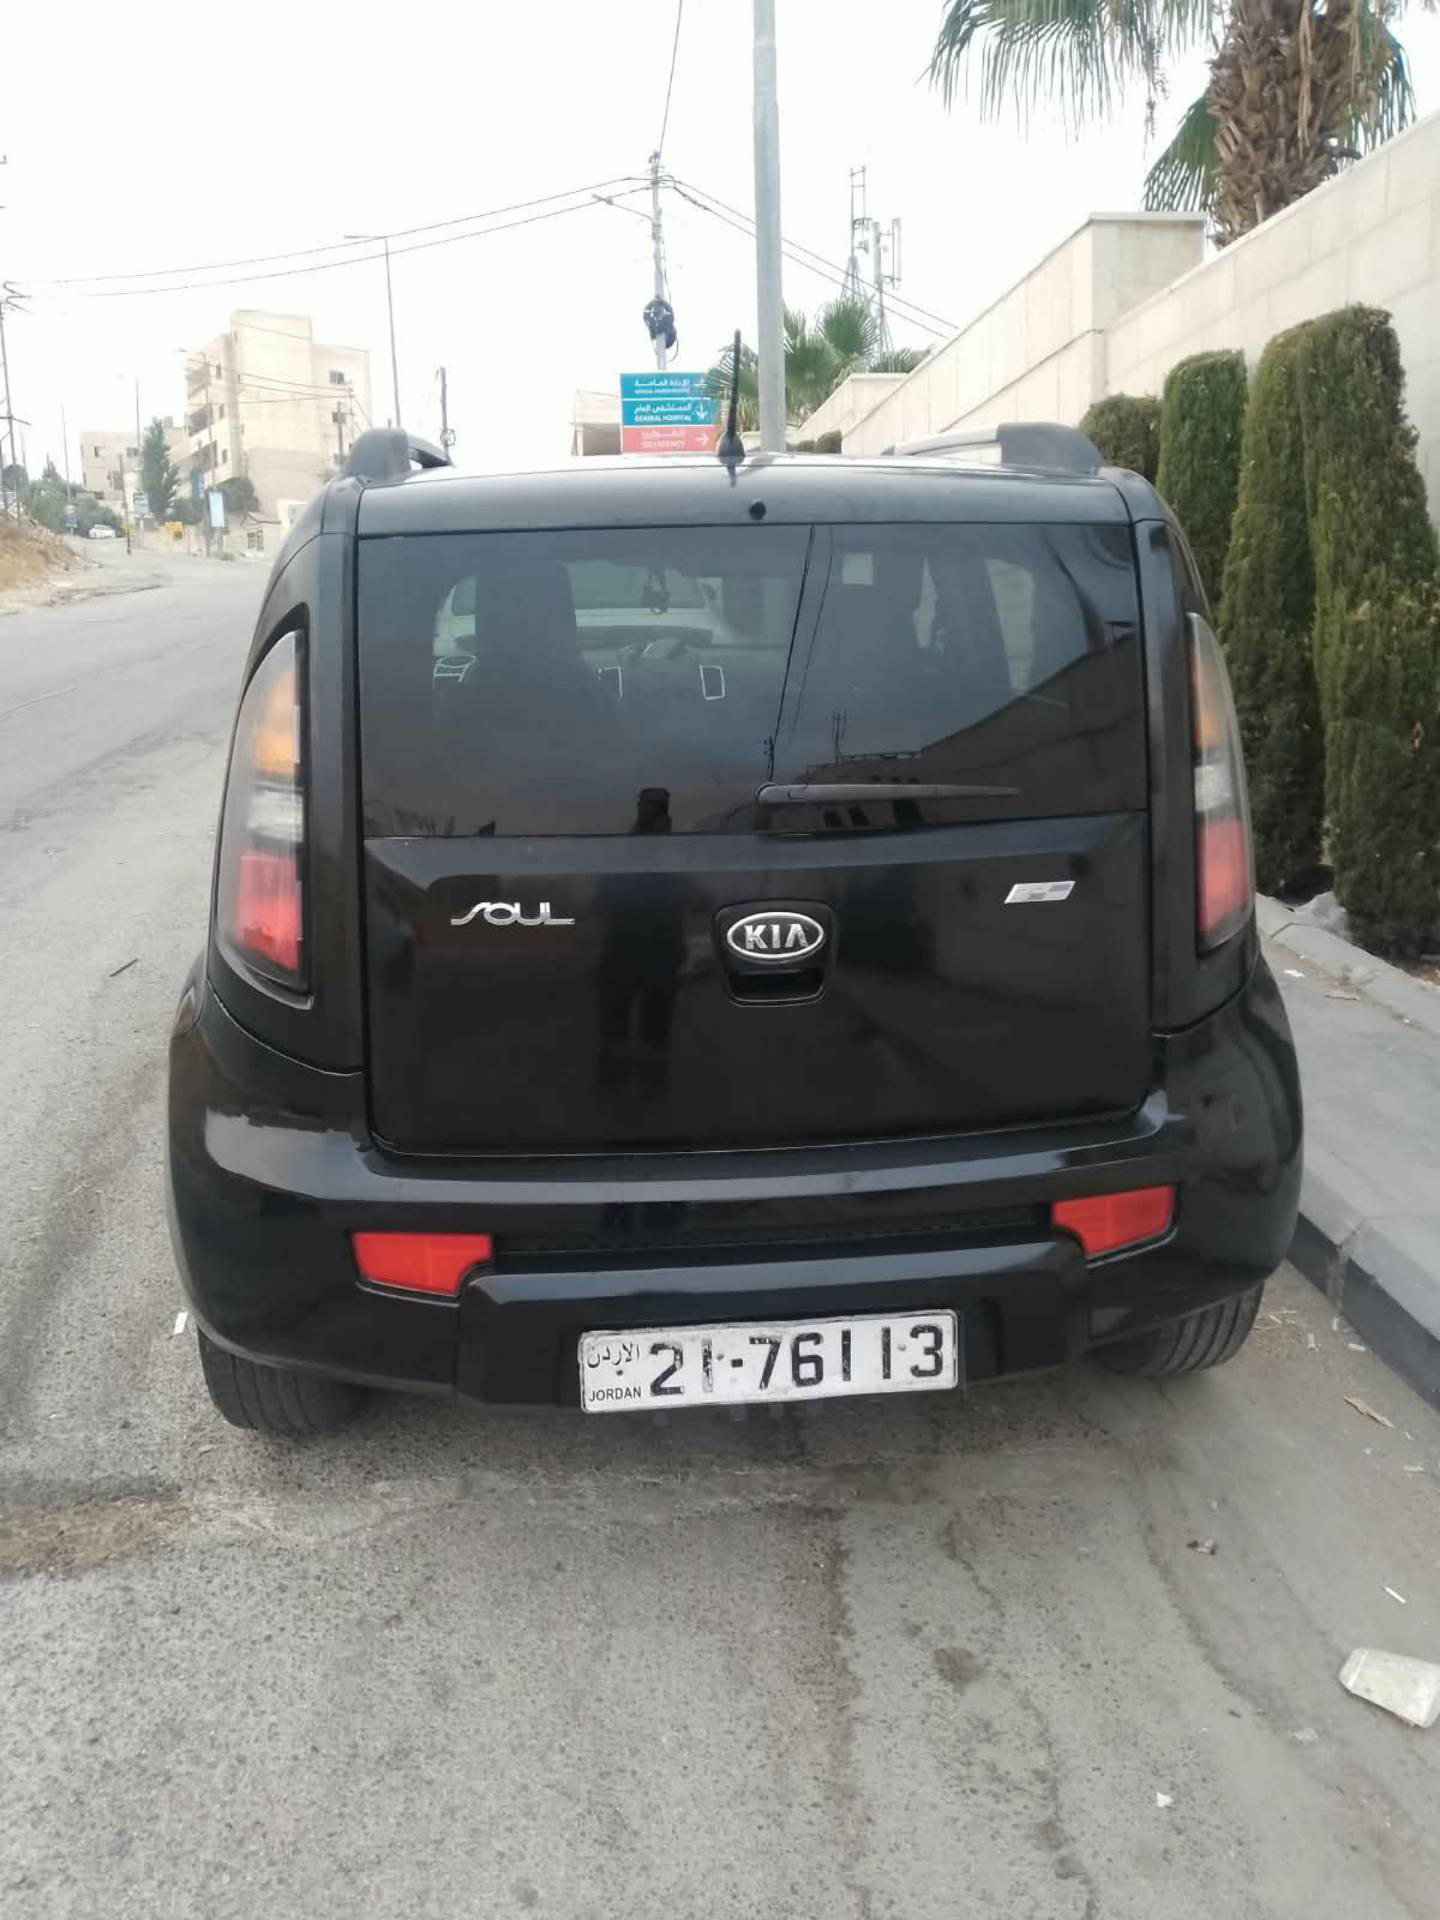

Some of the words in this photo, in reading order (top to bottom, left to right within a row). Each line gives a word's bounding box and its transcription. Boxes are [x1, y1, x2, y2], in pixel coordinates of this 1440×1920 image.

[450, 902, 576, 926] SOUL
[743, 923, 810, 950] KIA
[649, 1324, 945, 1397] 21-76113
[589, 1386, 642, 1402] JORDAN
